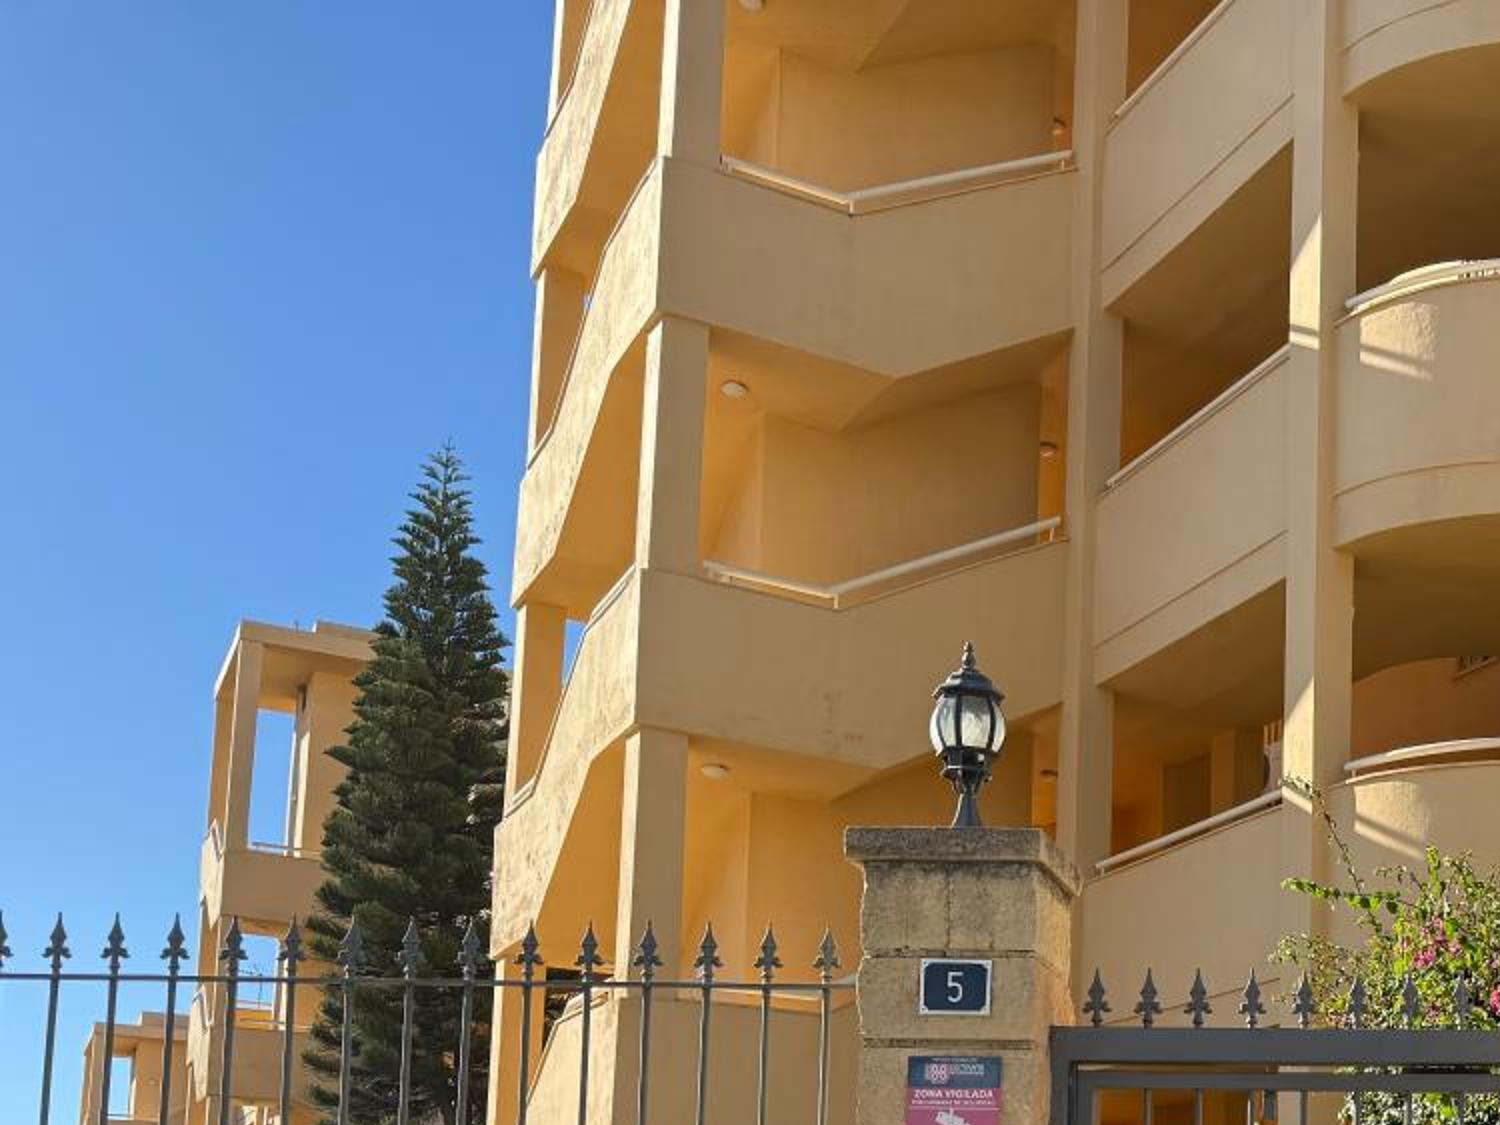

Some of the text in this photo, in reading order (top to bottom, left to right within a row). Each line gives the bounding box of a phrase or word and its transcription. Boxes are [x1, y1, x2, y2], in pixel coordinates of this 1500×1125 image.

[946, 970, 964, 1004] 5
[913, 1089, 994, 1099] ZONA VIGILADA
